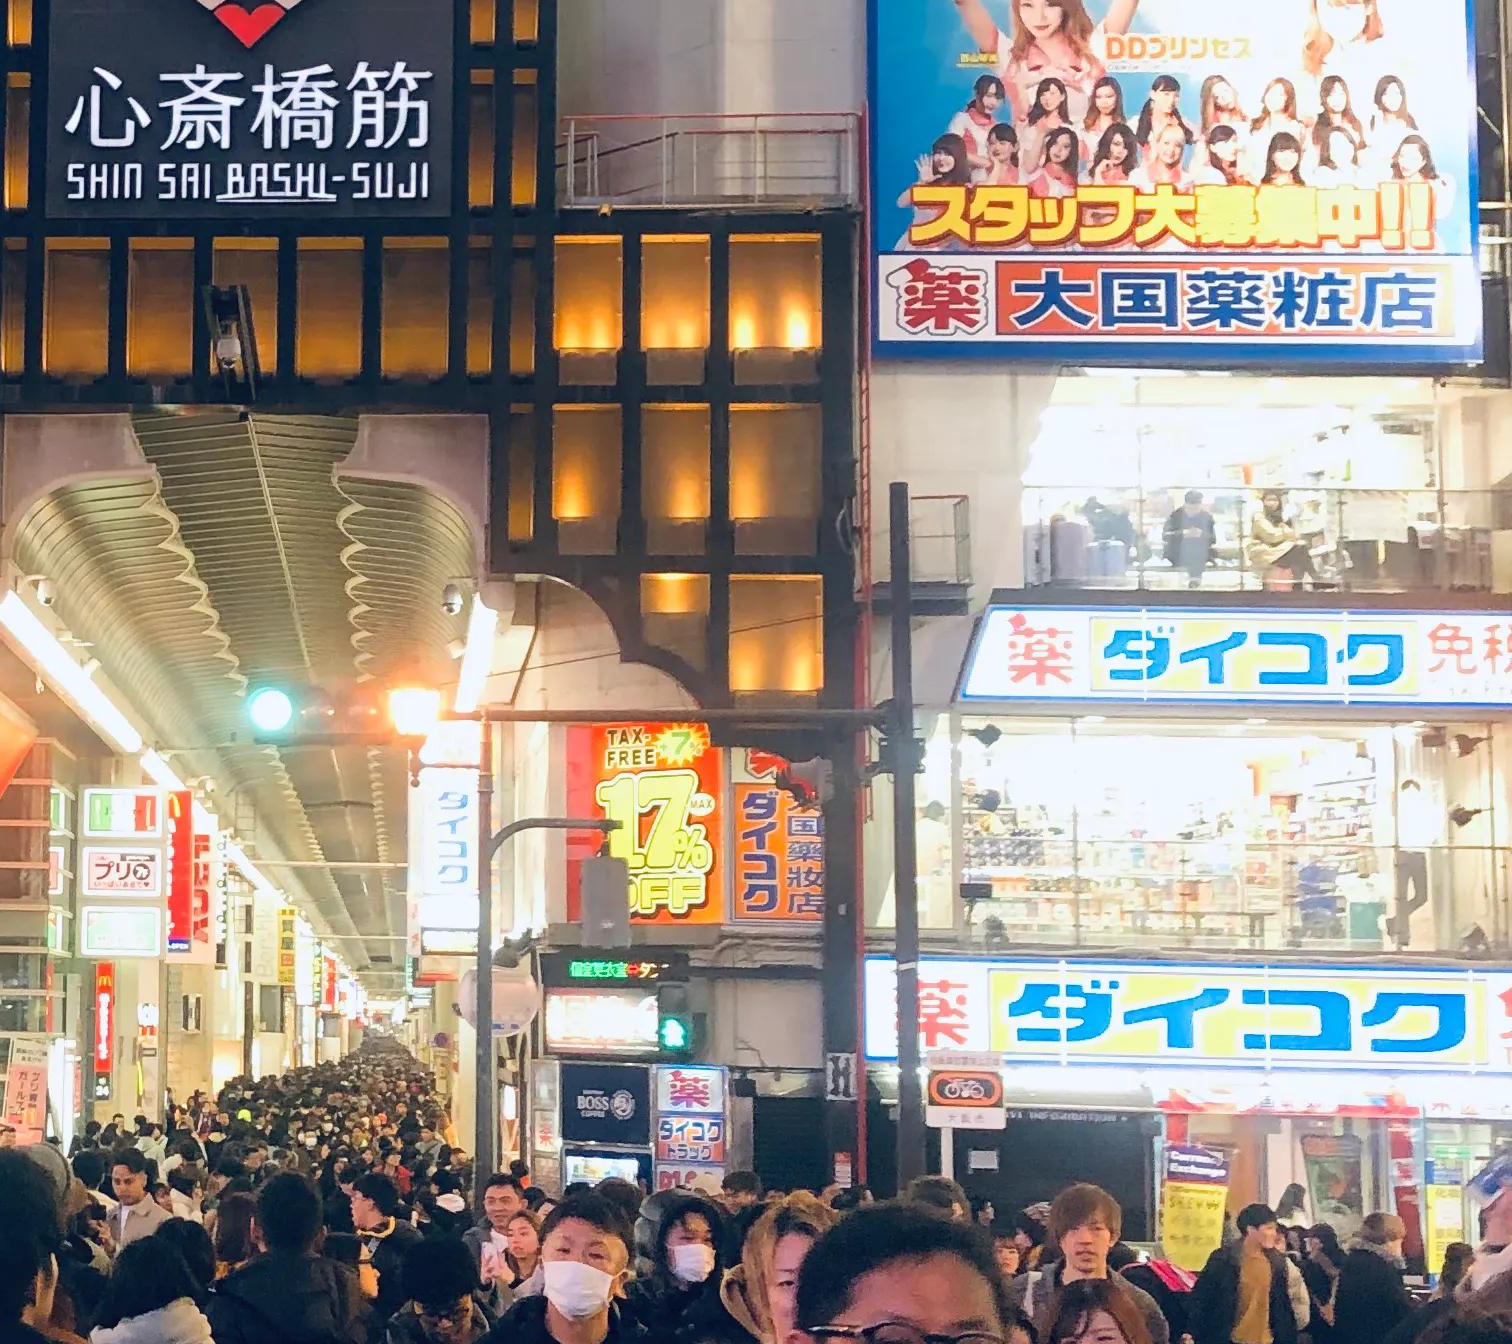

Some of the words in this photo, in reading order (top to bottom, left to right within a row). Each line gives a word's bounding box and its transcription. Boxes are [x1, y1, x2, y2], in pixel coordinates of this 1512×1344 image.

[64, 60, 433, 152] 心斎橋筋
[67, 163, 143, 200] SHIN
[158, 163, 210, 200] SAI
[909, 182, 1436, 250] スタッフ大募集中!!
[888, 258, 988, 336] 薬
[1011, 269, 1439, 331] 大国薬粧店
[1007, 613, 1074, 686] 薬
[1103, 626, 1405, 686] ダイコク
[606, 749, 655, 766] FREE
[607, 728, 651, 746] TAX-
[597, 771, 707, 874] 17%
[691, 799, 713, 809] MAX
[742, 790, 780, 913] ダイコク
[1008, 979, 1467, 1053] ダイコク
[577, 1095, 610, 1111] BOSS
[668, 1069, 711, 1109] 薬
